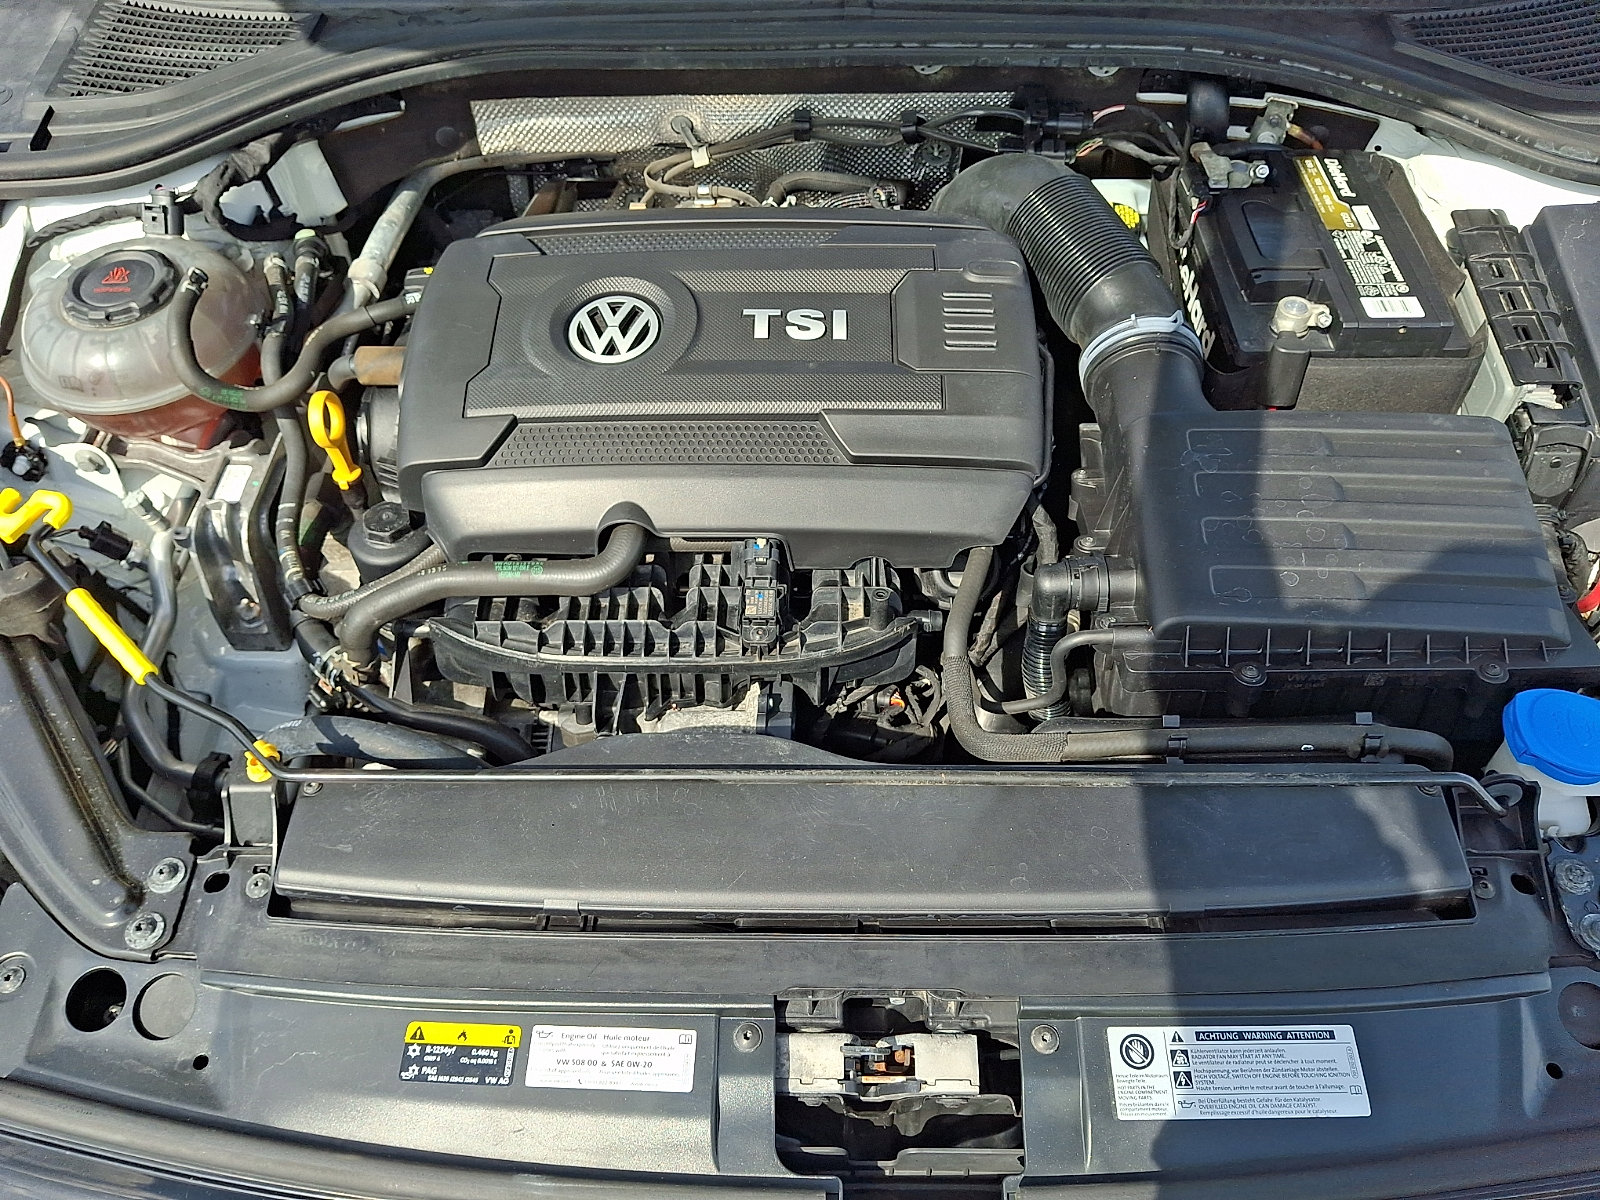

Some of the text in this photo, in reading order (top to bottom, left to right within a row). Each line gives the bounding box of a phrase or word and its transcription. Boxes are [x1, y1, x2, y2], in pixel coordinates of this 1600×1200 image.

[1323, 158, 1357, 197] DieHard
[1340, 212, 1355, 228] GOLD
[742, 308, 848, 341] TSI
[561, 1033, 585, 1041] Engine
[1199, 1031, 1330, 1040] ACHTUNG WARNING ATTENTION
[490, 1049, 499, 1058] kg
[626, 1060, 652, 1068] 0W-20
[421, 1066, 438, 1075] PAG
[498, 1077, 510, 1085] AG
